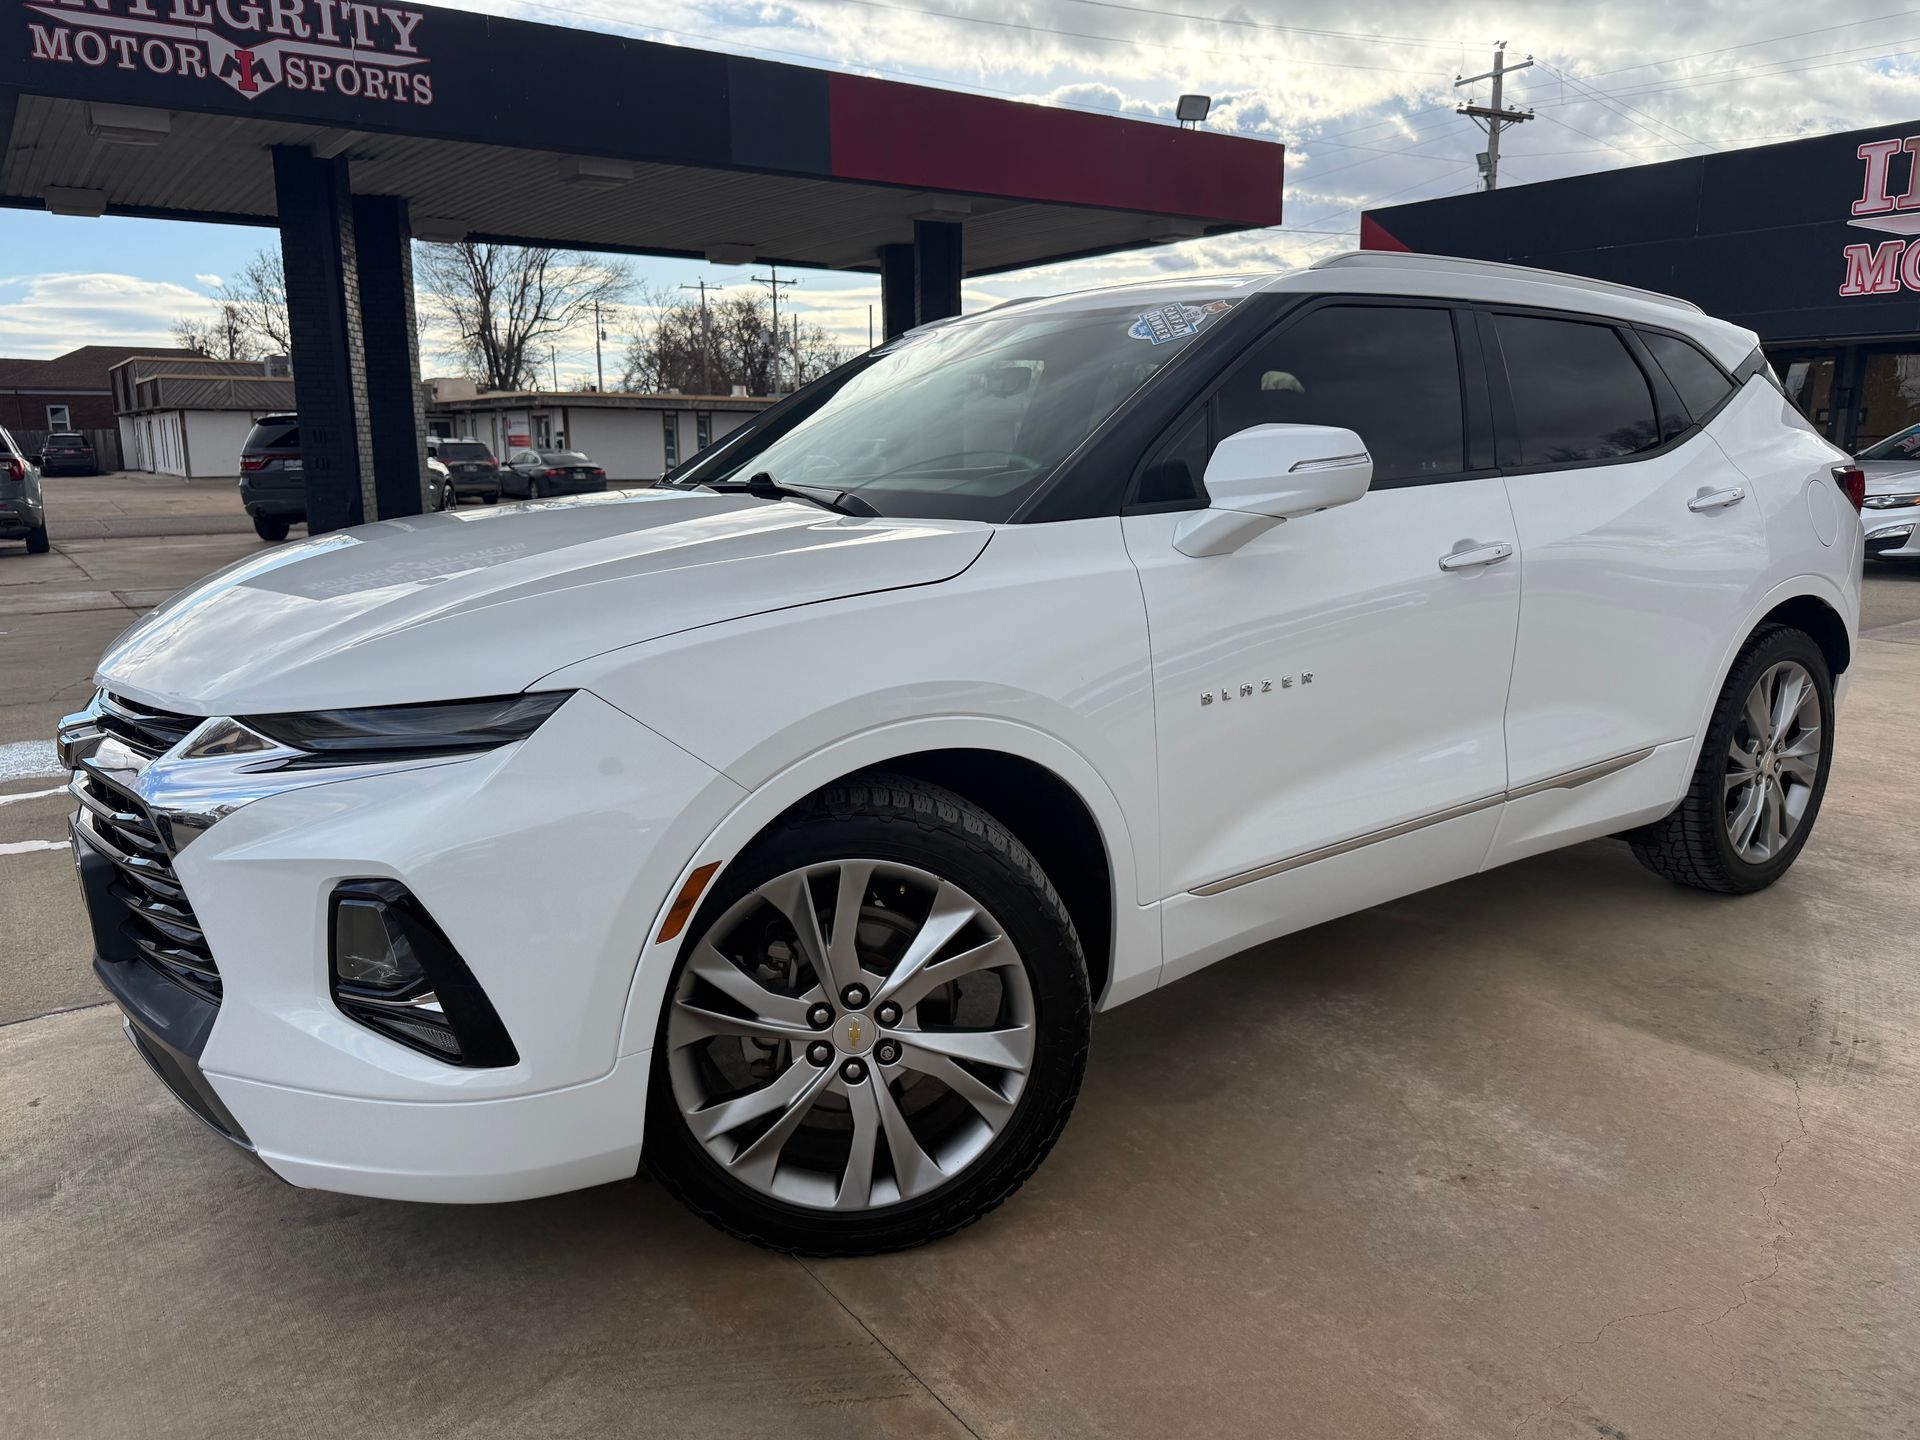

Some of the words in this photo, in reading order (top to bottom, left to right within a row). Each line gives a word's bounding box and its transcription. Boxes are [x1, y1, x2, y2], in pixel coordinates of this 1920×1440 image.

[28, 24, 207, 78] MOTOR
[285, 56, 433, 105] SPORTS
[1162, 306, 1188, 336] CARFAX
[1200, 670, 1314, 706] BLAZER
